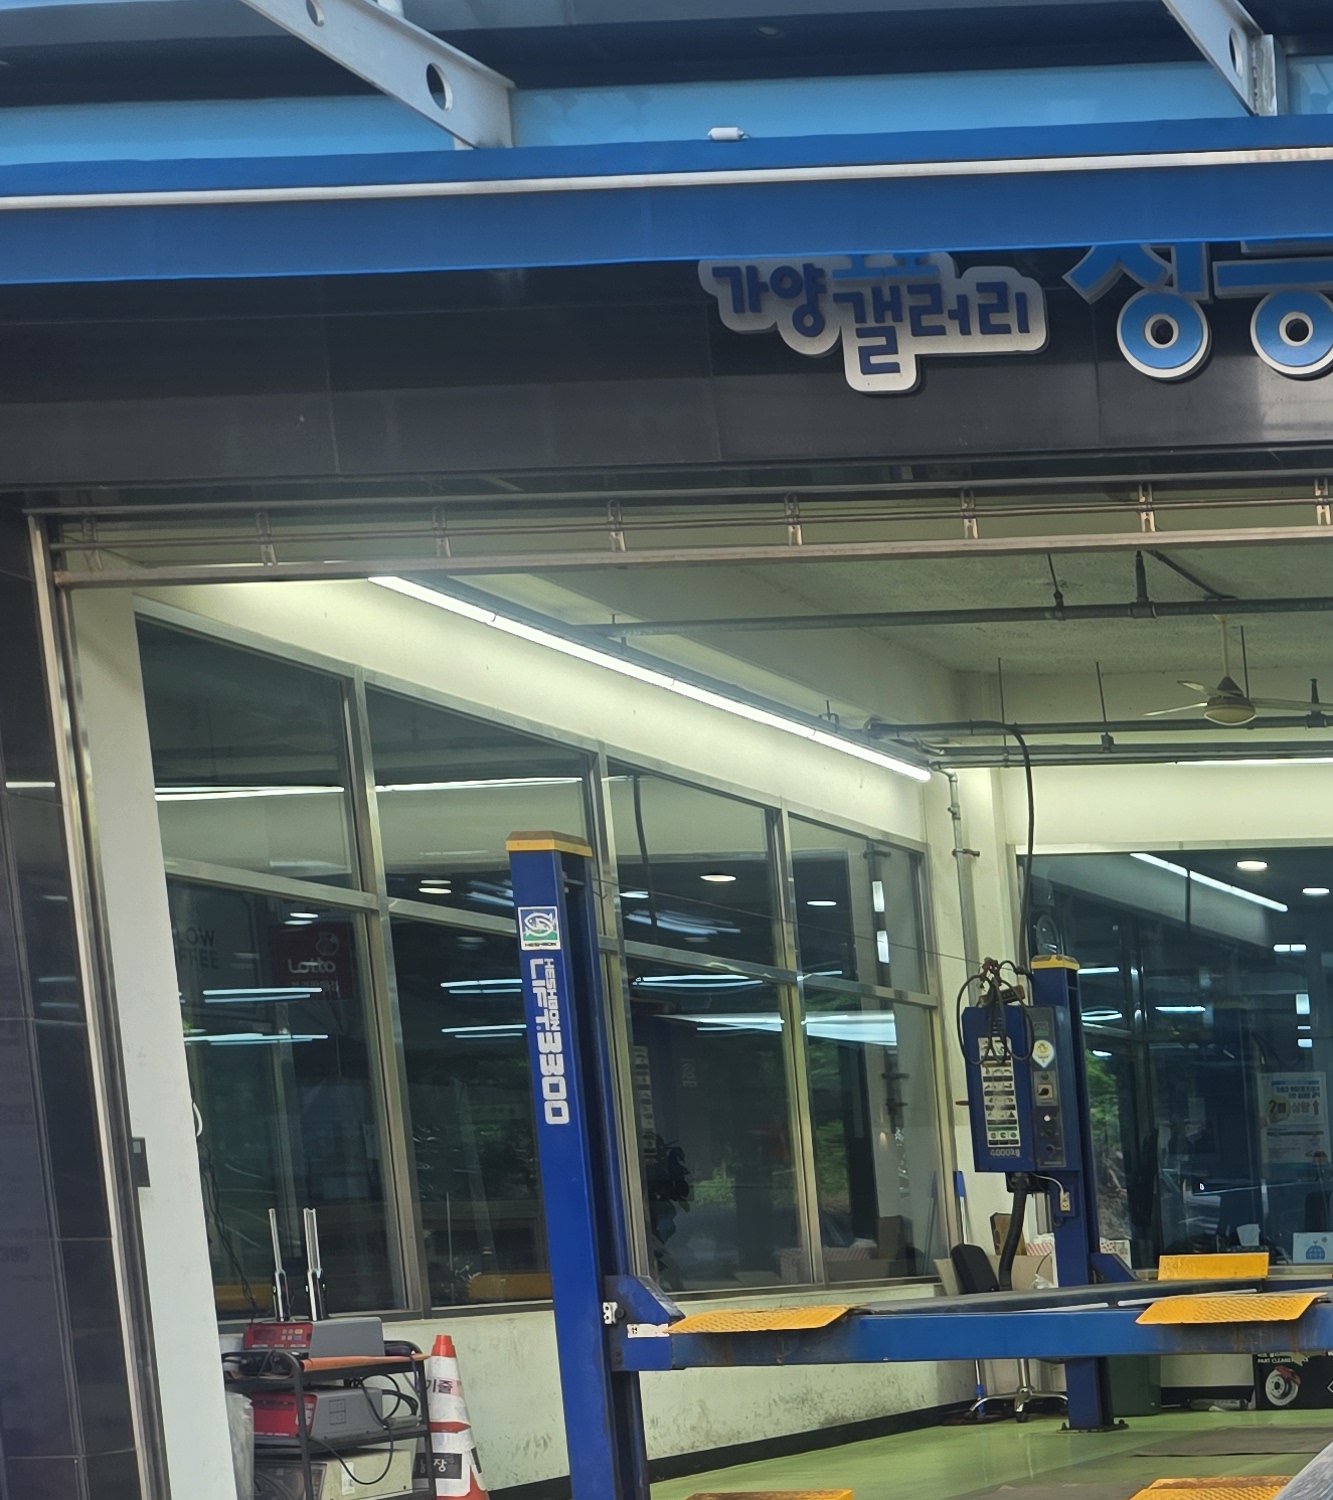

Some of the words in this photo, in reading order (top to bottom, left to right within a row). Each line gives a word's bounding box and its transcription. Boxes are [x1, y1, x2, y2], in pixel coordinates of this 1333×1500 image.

[177, 927, 216, 948] LOW
[543, 957, 562, 1032] HESHBON
[536, 1032, 570, 1125] 3300
